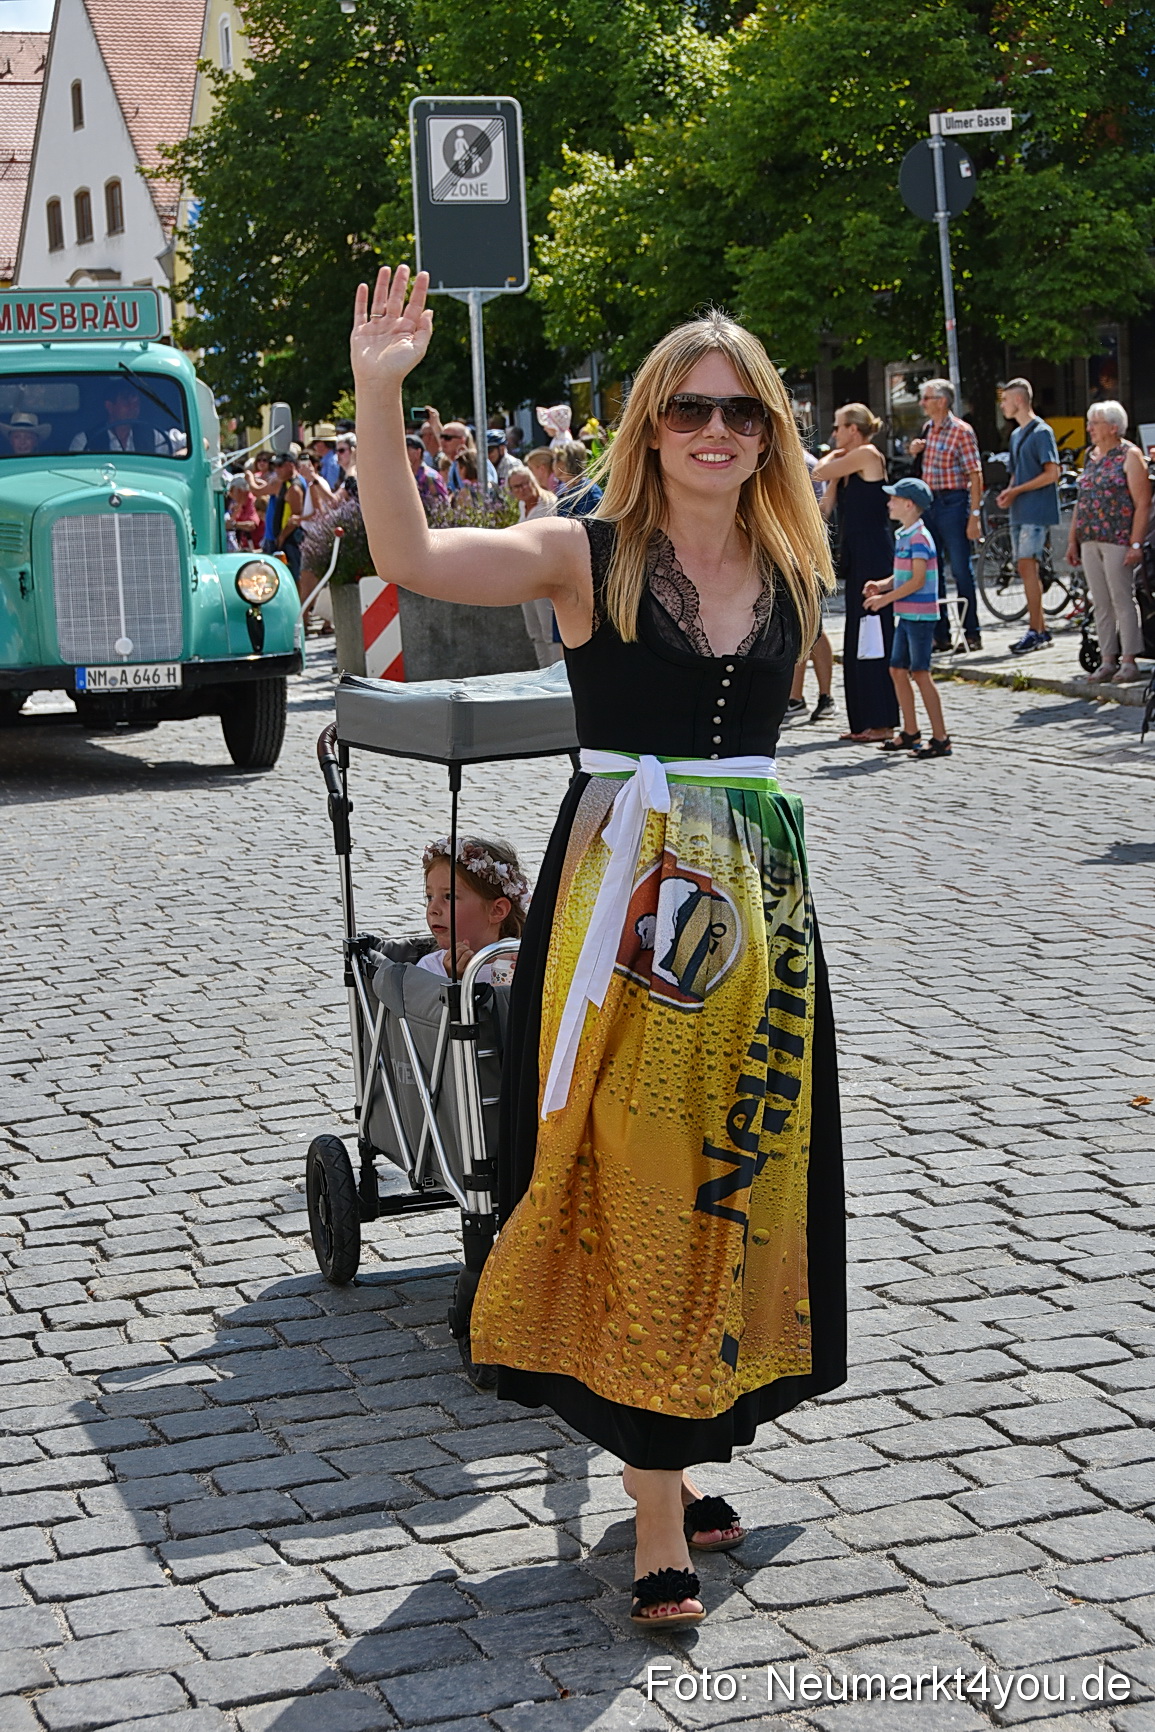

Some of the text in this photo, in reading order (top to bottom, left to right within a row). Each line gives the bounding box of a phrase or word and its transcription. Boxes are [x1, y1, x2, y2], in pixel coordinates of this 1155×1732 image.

[945, 114, 1007, 130] Ulmer Gasse
[450, 182, 489, 197] ZONE
[87, 669, 107, 687] NM
